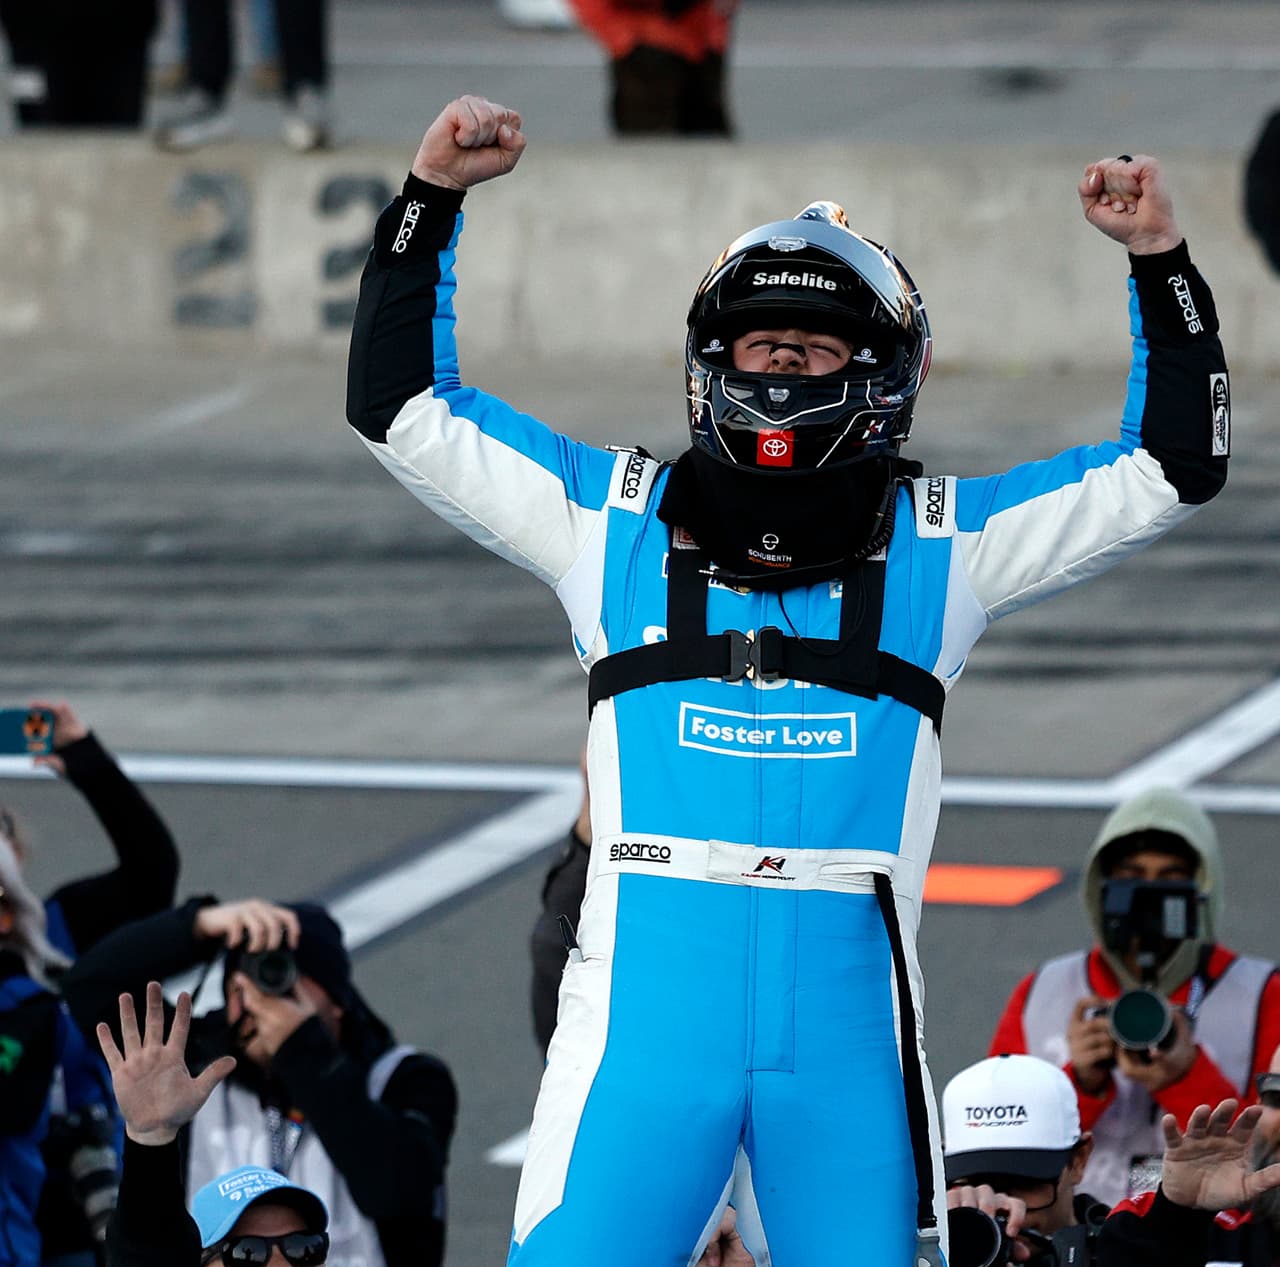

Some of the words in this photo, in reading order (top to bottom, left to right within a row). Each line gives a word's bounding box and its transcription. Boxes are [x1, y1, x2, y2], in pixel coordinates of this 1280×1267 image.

[752, 271, 838, 291] Safelite
[620, 456, 646, 499] parco
[747, 548, 793, 564] SCHUBERTH
[690, 716, 776, 746] Foster
[782, 725, 844, 747] Love
[609, 842, 672, 864] sparco
[965, 1105, 1028, 1120] TOYOTA
